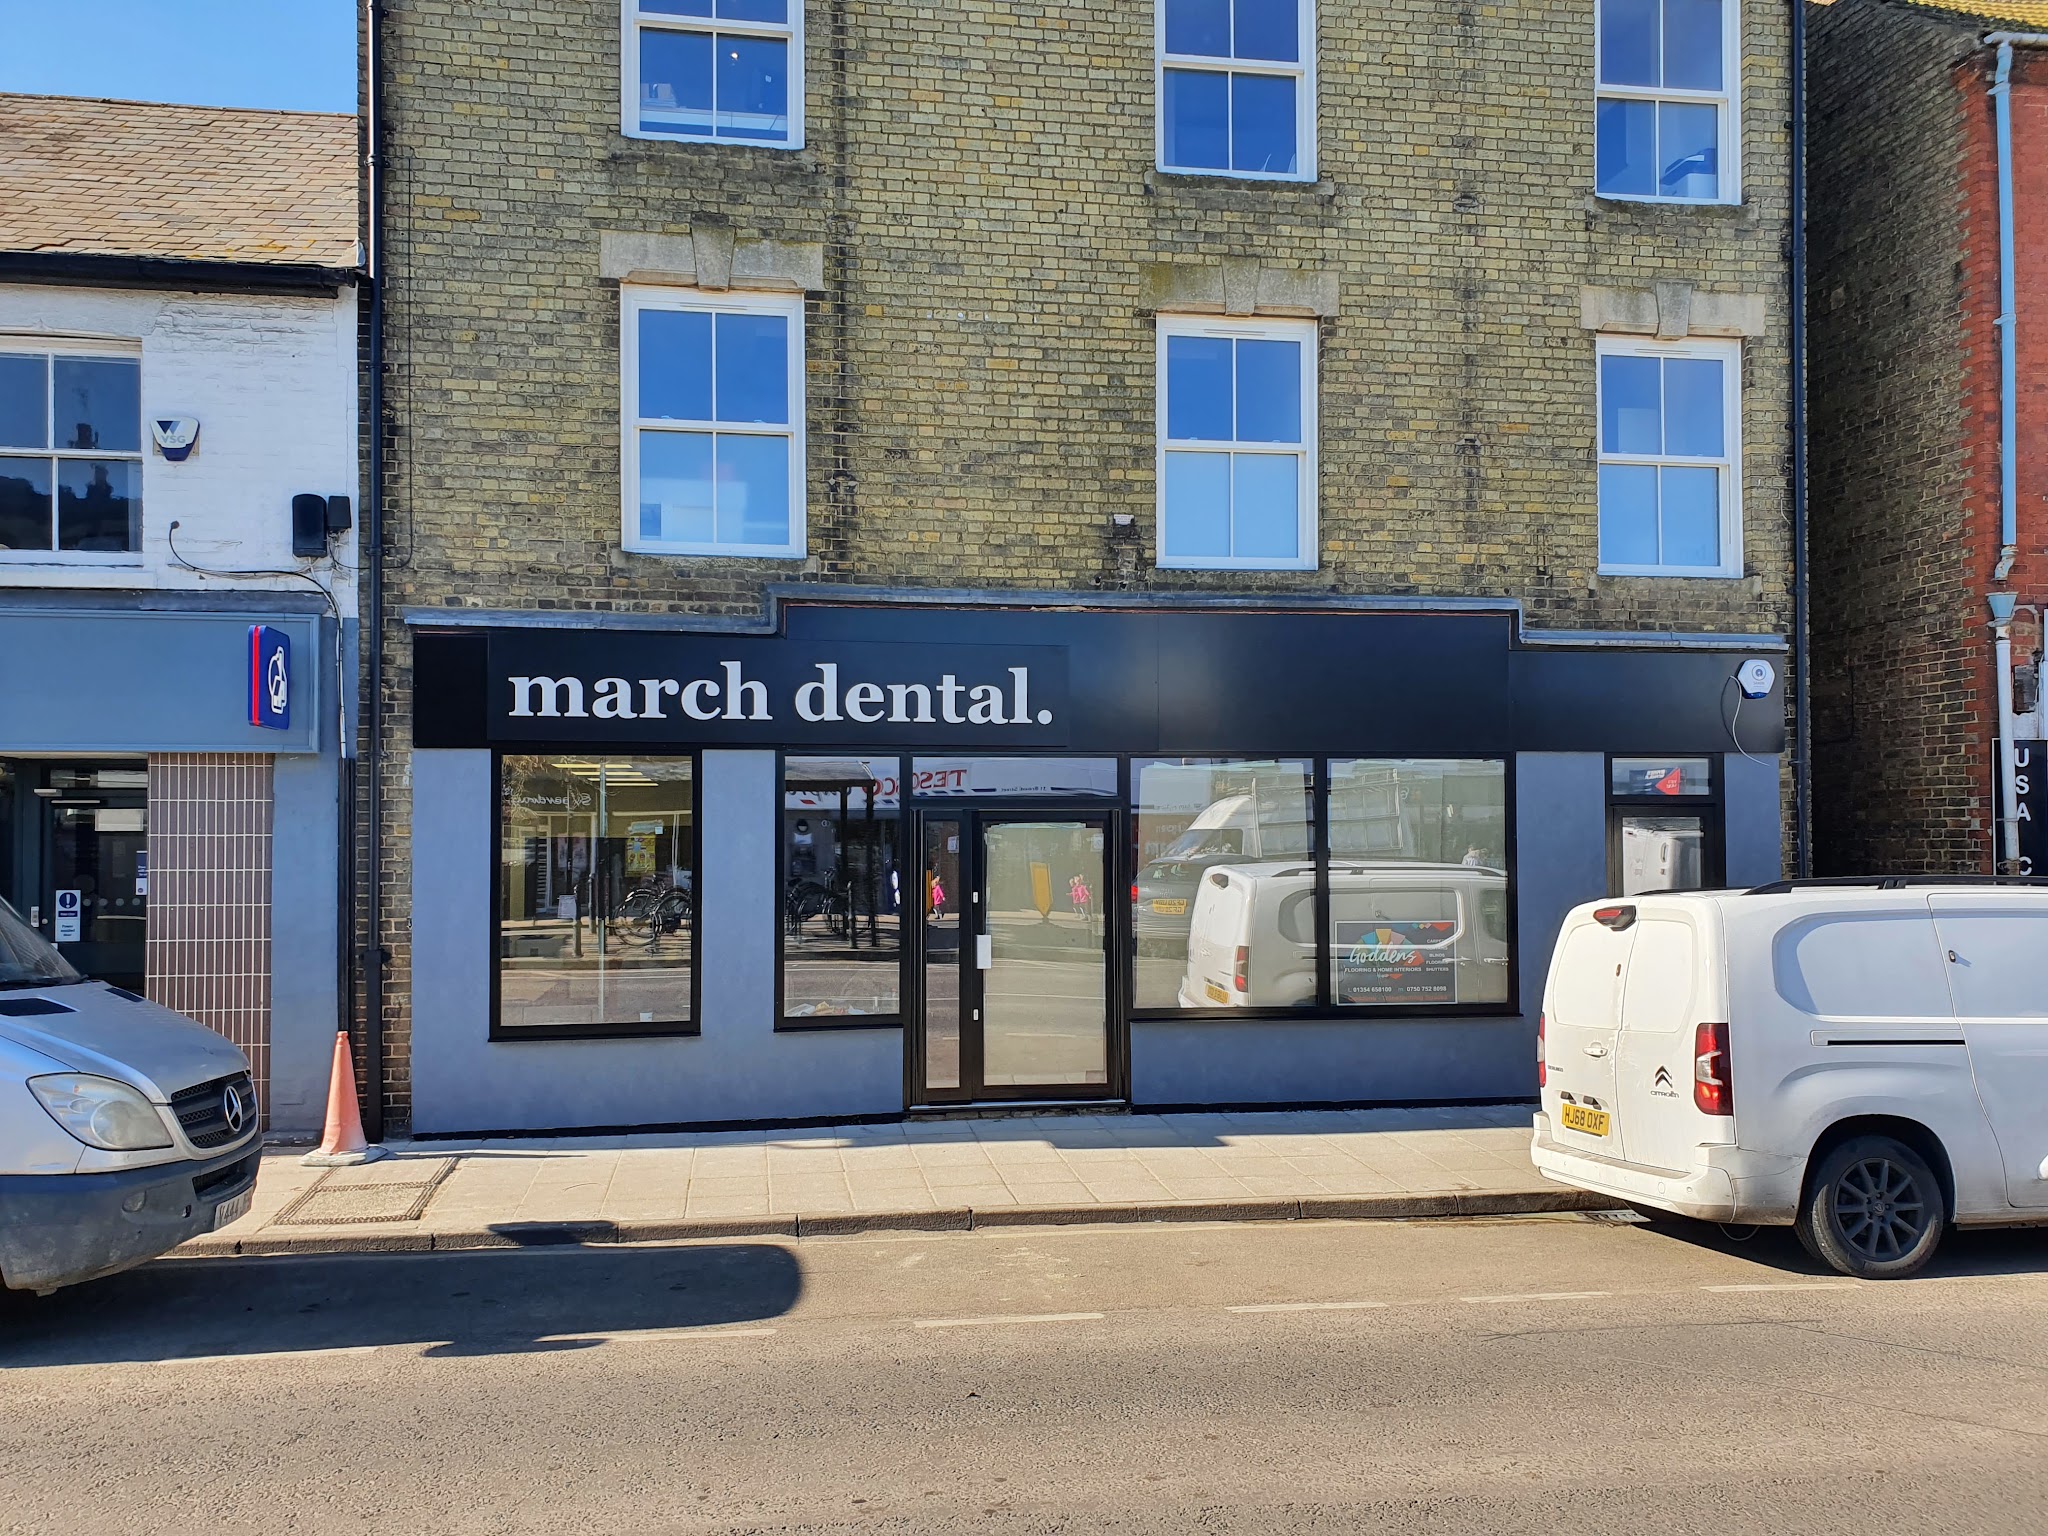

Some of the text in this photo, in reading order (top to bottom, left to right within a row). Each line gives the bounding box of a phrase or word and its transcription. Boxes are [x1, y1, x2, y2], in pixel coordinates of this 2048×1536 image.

[161, 435, 186, 444] VSG
[508, 661, 1054, 726] march dental.
[1349, 940, 1417, 966] Goddens
[1563, 1105, 1606, 1132] HJ68 OXF
